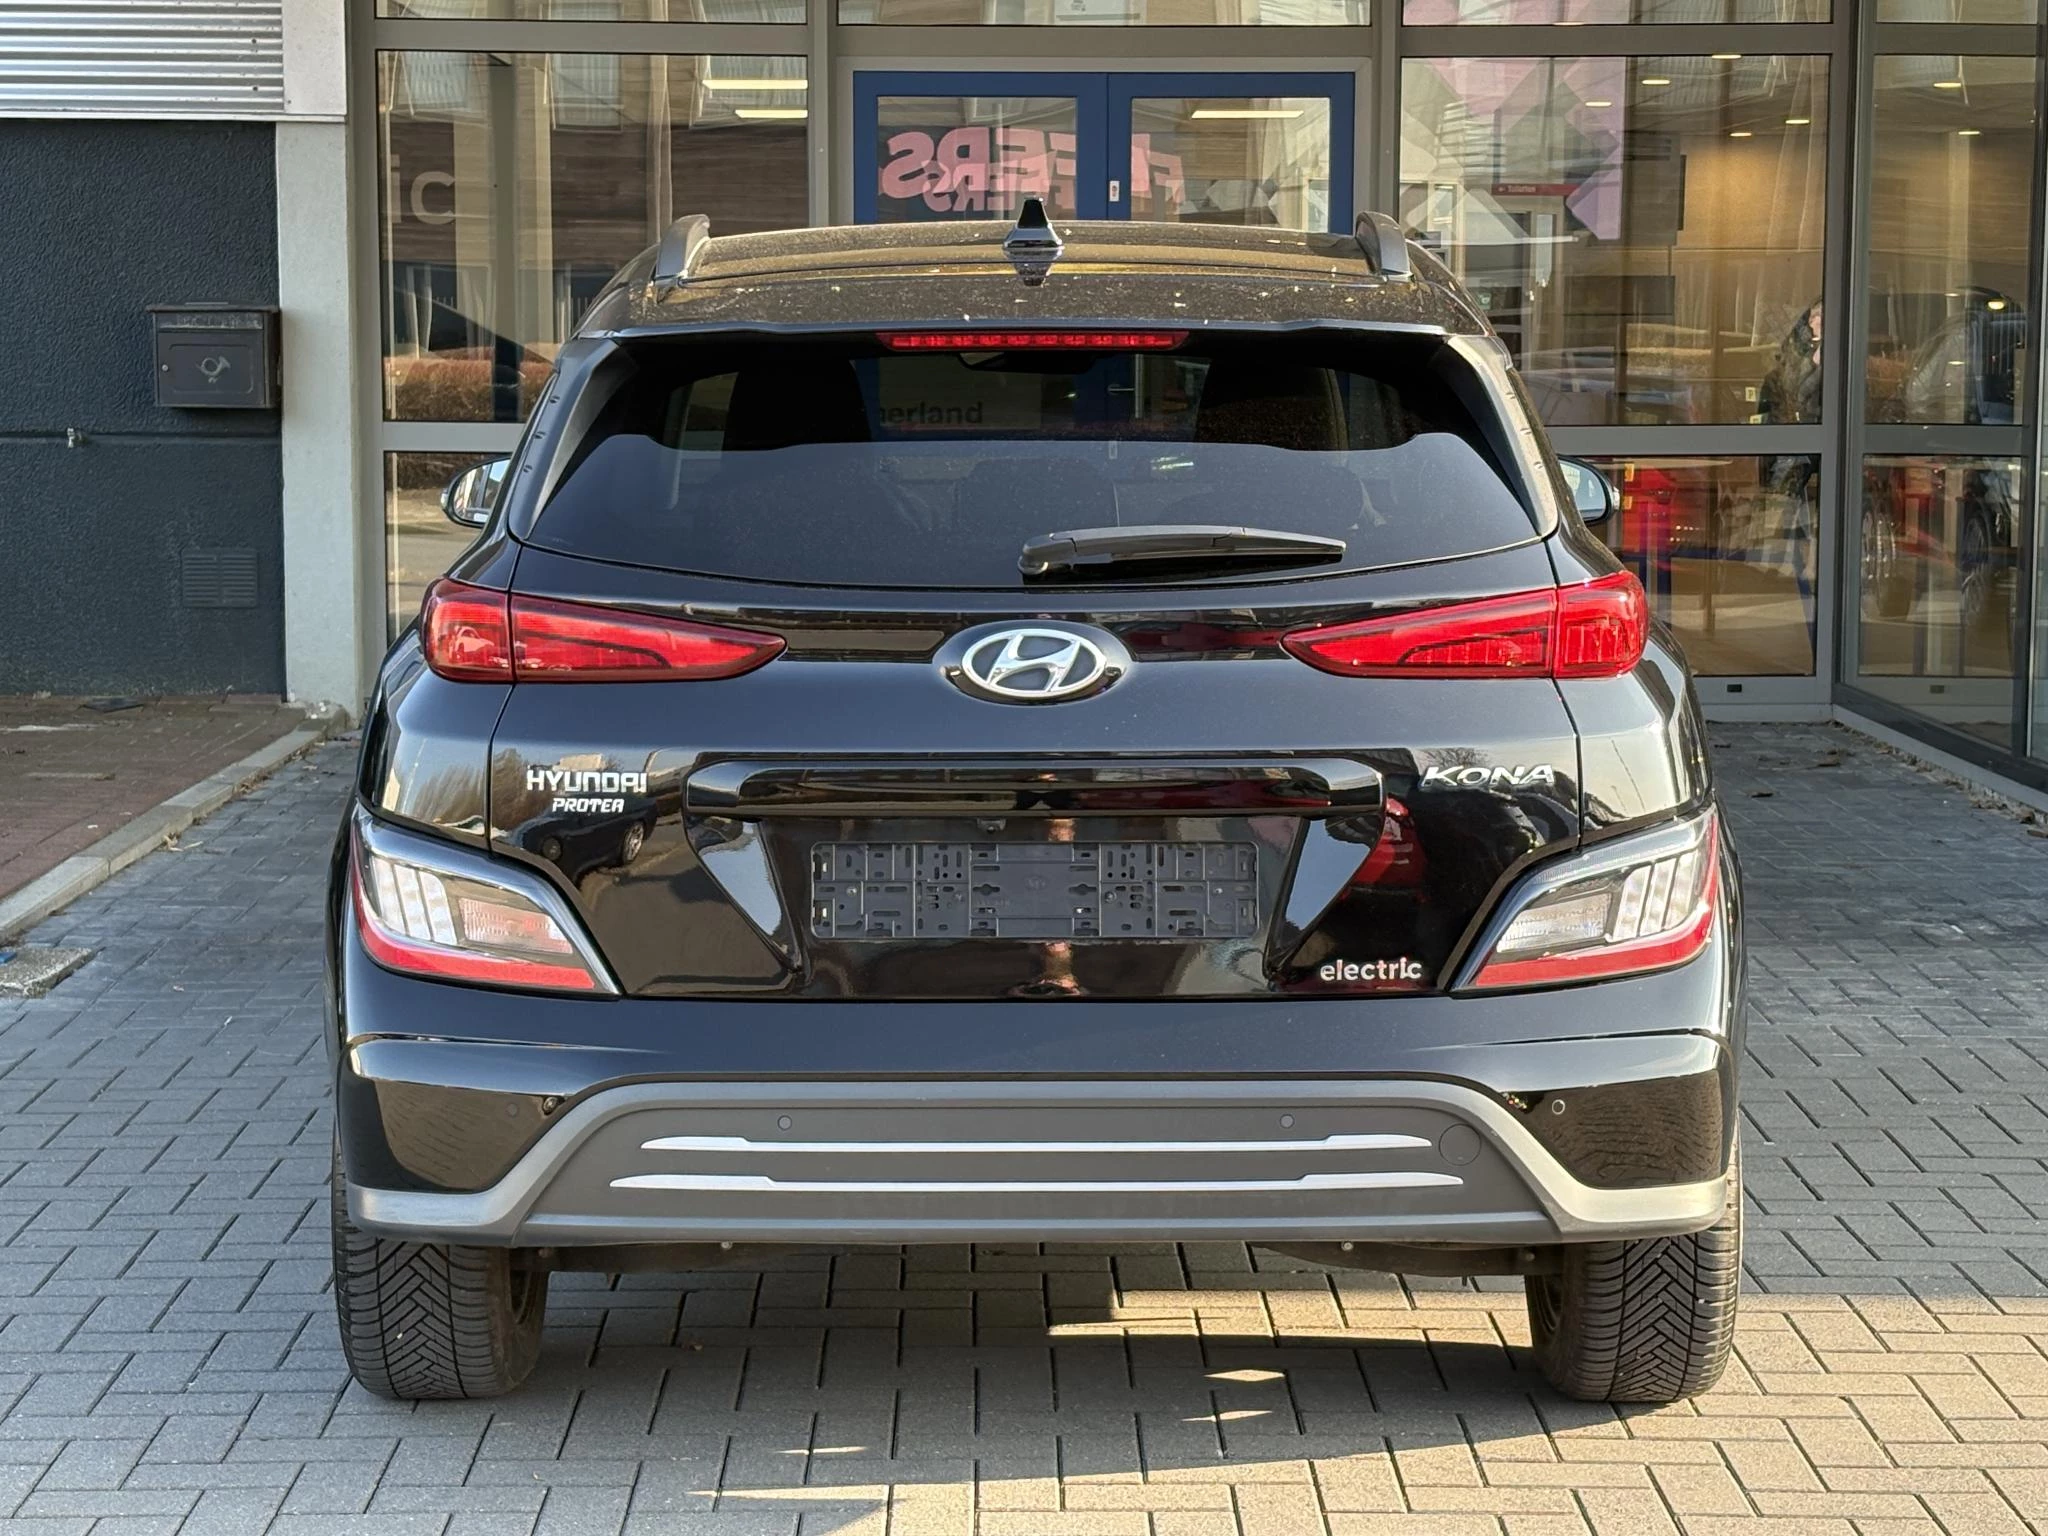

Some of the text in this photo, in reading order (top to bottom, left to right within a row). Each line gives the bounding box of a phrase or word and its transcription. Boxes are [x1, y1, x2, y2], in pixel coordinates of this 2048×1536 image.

[526, 769, 648, 793] HYUNDAI
[1420, 765, 1555, 787] KONA
[551, 797, 625, 813] PROTEA
[1320, 956, 1422, 981] electric
